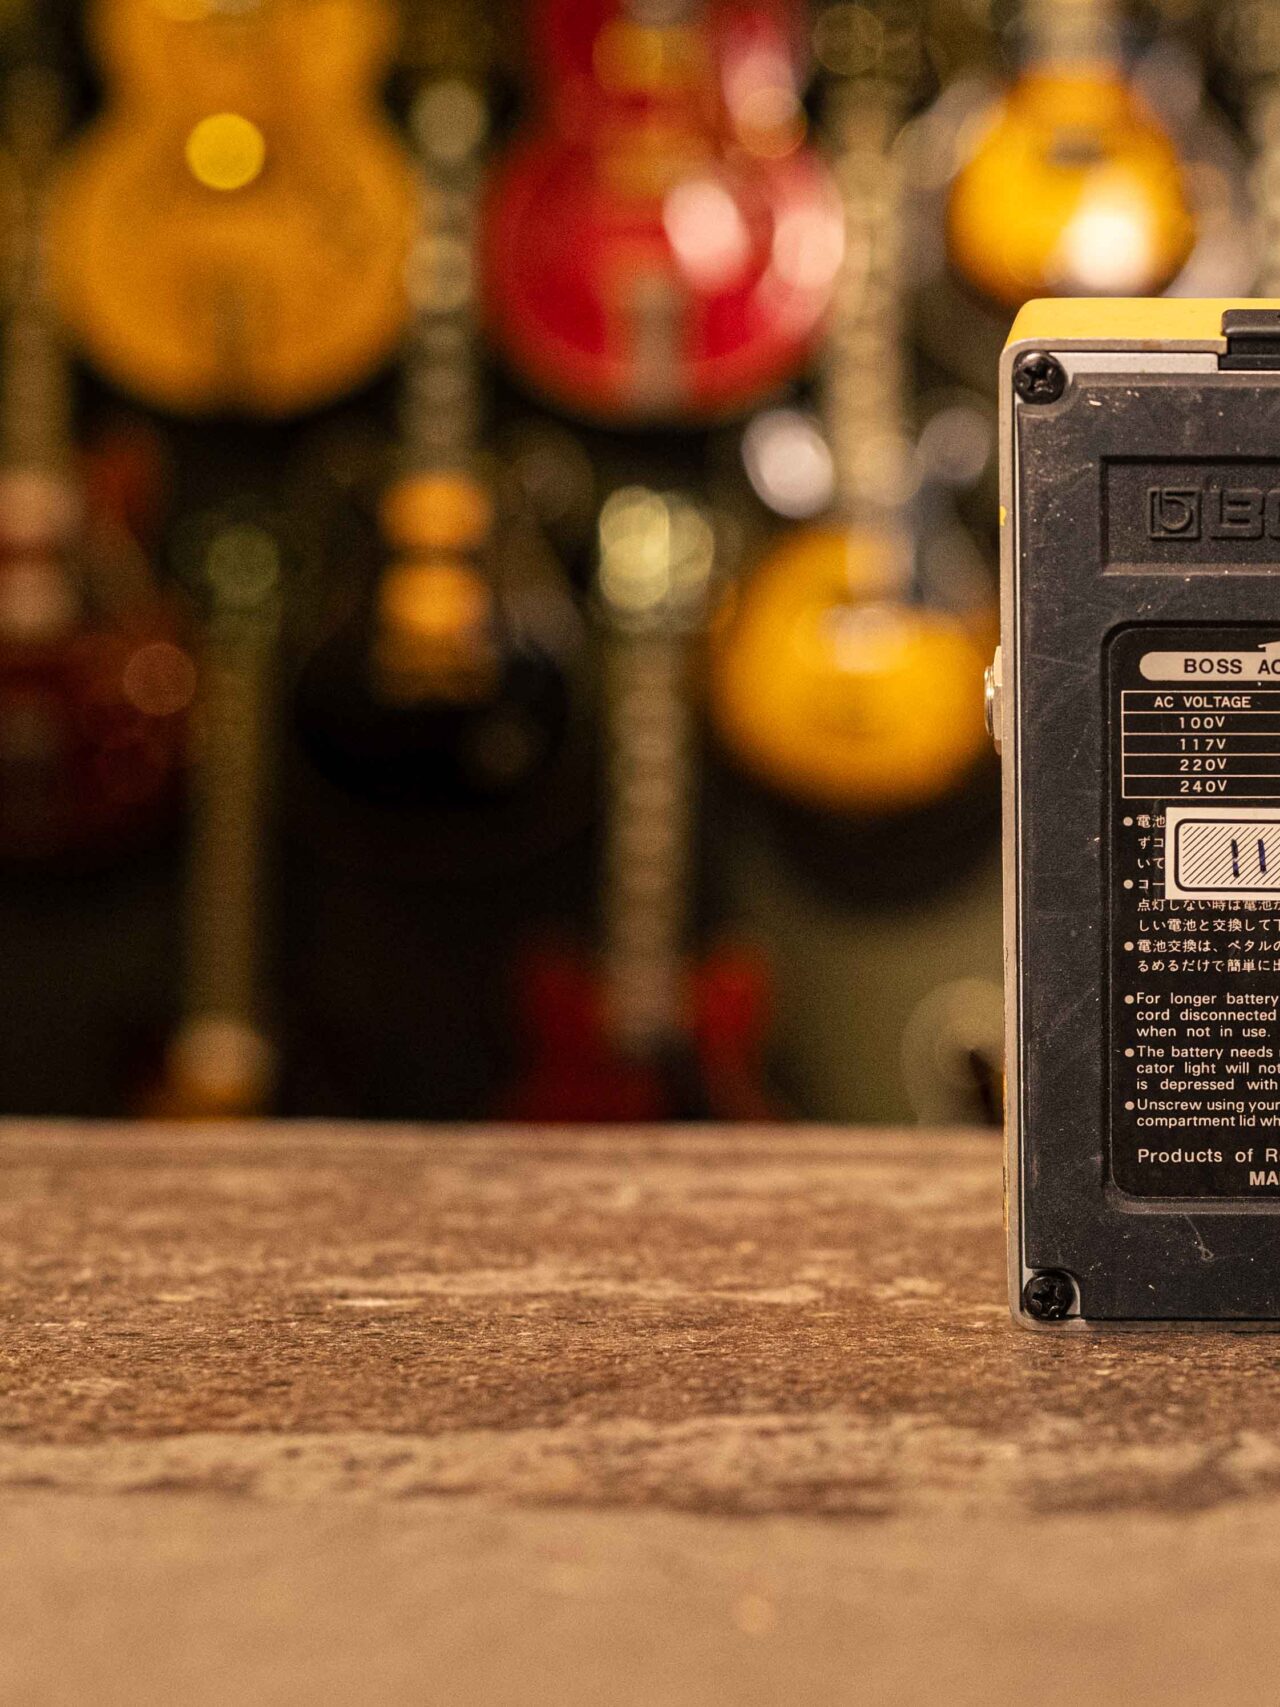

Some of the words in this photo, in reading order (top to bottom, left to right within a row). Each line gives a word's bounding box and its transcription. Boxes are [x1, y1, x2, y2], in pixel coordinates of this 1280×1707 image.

[1183, 658, 1243, 675] BOSS
[1153, 696, 1175, 709] AC
[1183, 696, 1252, 709] VOLTAGE
[1179, 715, 1227, 729] 100V
[1179, 737, 1227, 751] 117V
[1179, 757, 1227, 772] 220V
[1180, 779, 1227, 793] 240V
[1136, 991, 1161, 1005] For
[1170, 992, 1217, 1007] longer
[1226, 992, 1279, 1007] battery
[1136, 1008, 1170, 1021] cord
[1179, 1008, 1277, 1021] disconnected
[1136, 1025, 1177, 1037] when
[1186, 1026, 1211, 1038] not
[1220, 1025, 1233, 1037] in
[1242, 1028, 1271, 1038] use.
[1136, 1045, 1165, 1058] The
[1171, 1045, 1224, 1060] battery
[1230, 1045, 1274, 1058] needs
[1136, 1063, 1175, 1074] cator
[1184, 1061, 1216, 1077] light
[1225, 1061, 1250, 1074] will
[1136, 1078, 1148, 1090] is
[1160, 1078, 1235, 1093] depressed
[1246, 1078, 1278, 1091] with
[1136, 1098, 1203, 1111] Unscrew
[1206, 1098, 1245, 1113] using
[1248, 1101, 1280, 1113] your
[1136, 1115, 1236, 1129] compartment
[1239, 1114, 1256, 1127] lid
[1138, 1148, 1223, 1163] Products
[1234, 1148, 1254, 1163] of
